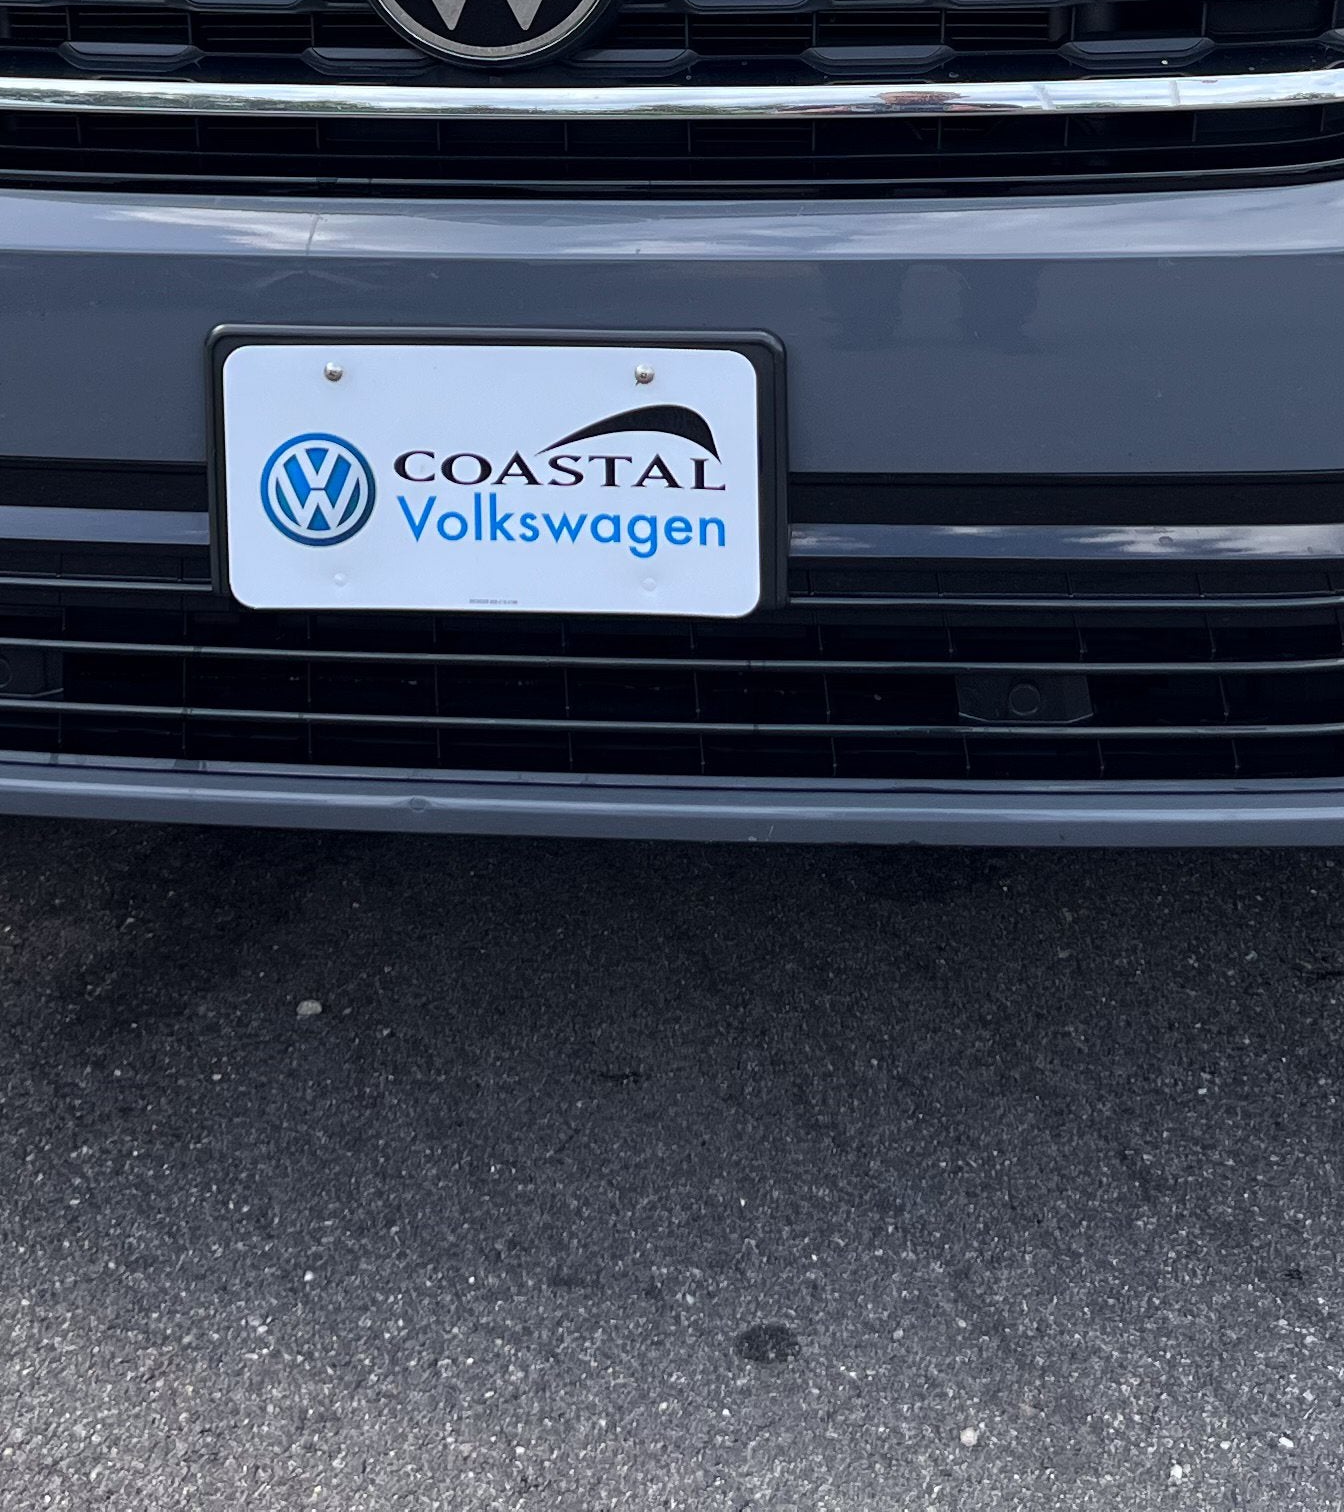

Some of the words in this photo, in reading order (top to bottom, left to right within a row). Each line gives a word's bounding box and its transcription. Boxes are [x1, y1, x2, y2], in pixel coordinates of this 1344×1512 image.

[265, 439, 370, 541] VW
[393, 450, 726, 491] COASTAL
[396, 490, 727, 560] Volkswagen
